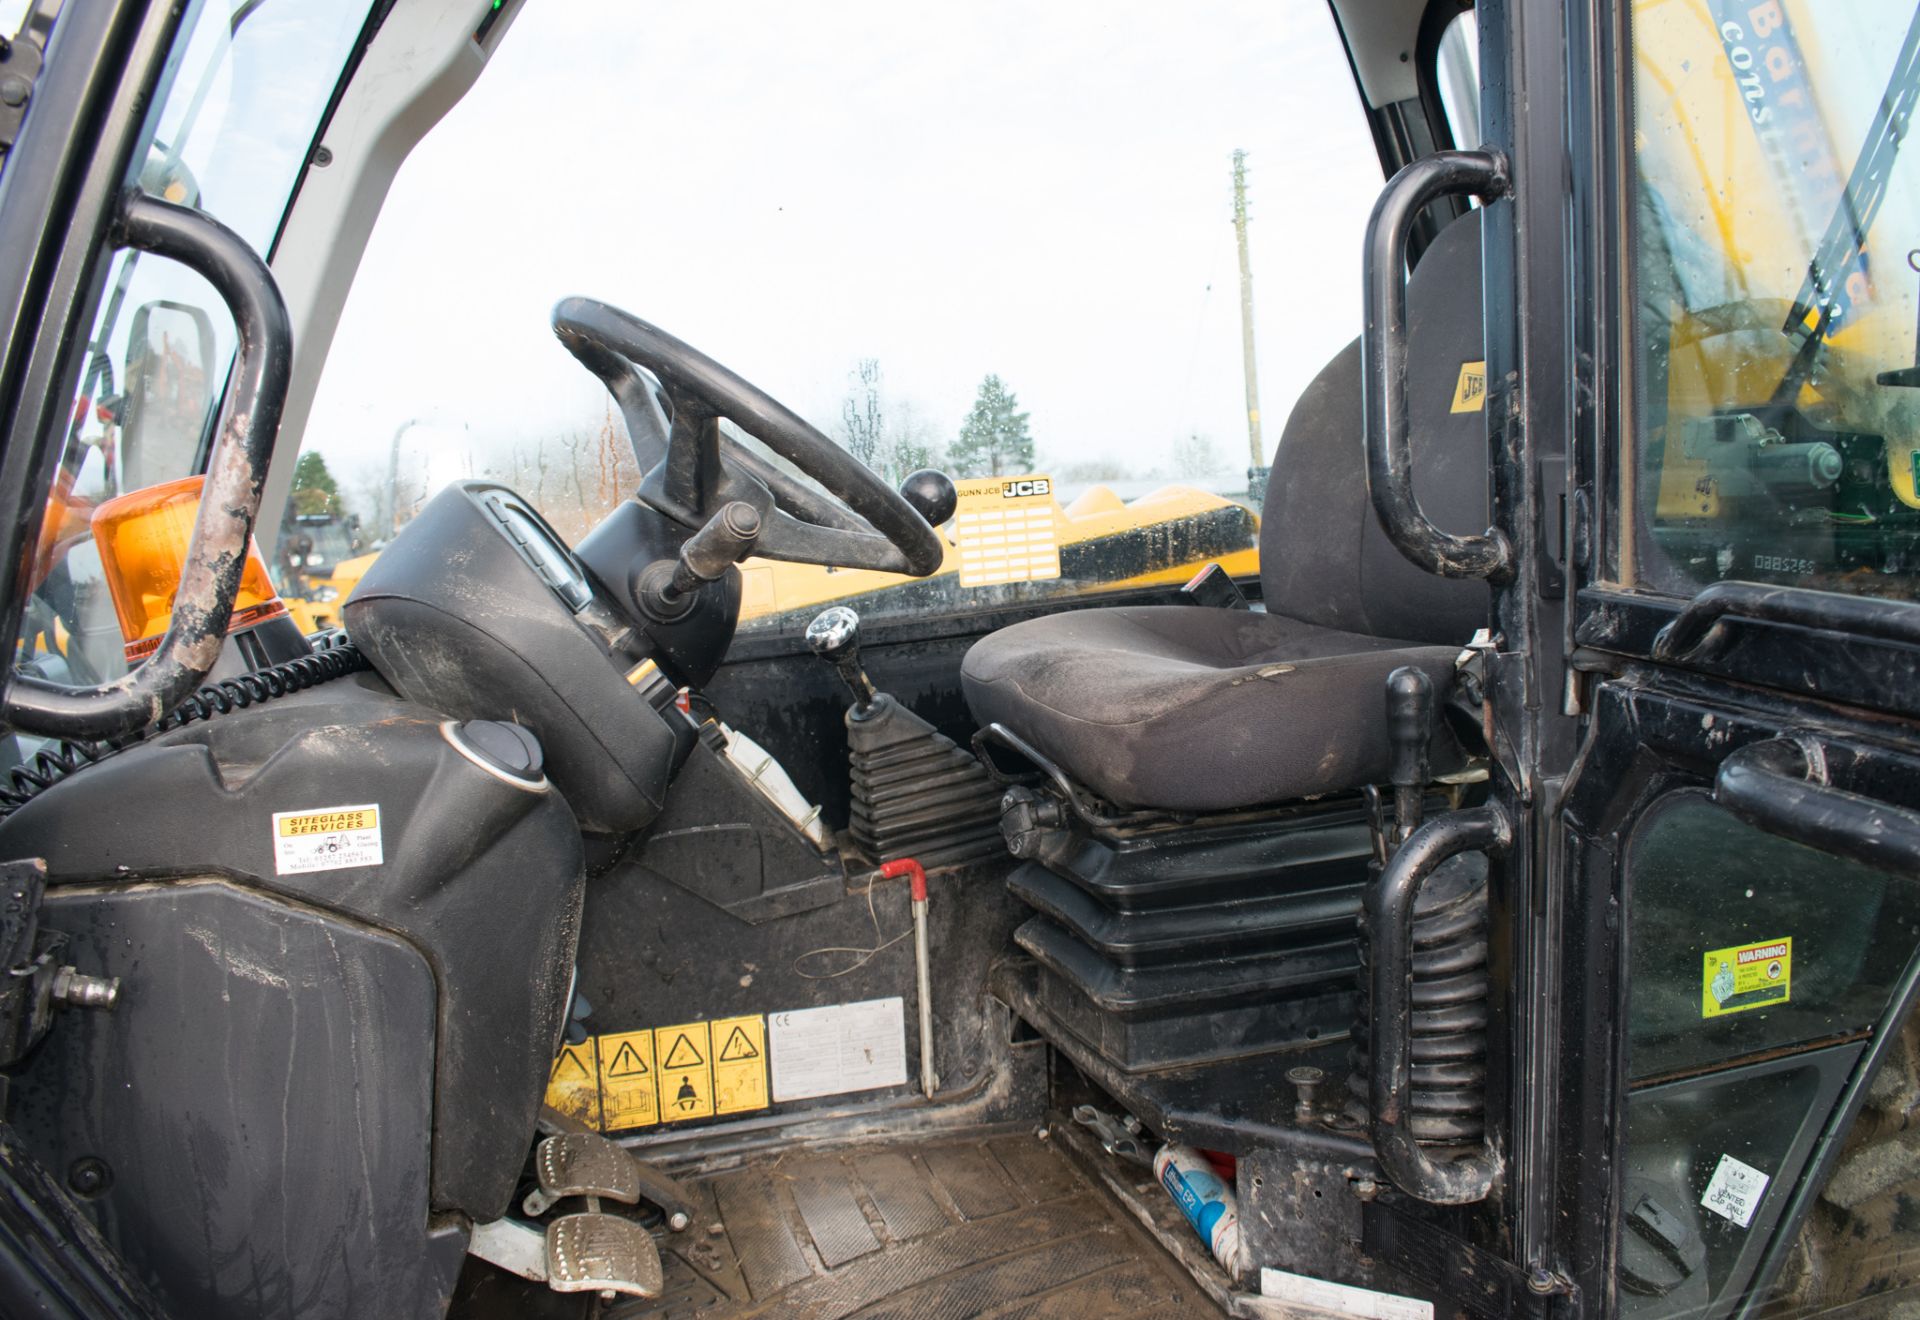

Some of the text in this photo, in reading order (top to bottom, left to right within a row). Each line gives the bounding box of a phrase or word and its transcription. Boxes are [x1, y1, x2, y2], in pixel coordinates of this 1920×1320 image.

[958, 487, 1000, 497] GUNN JCB
[1003, 480, 1049, 498] JCB
[290, 812, 363, 826] SITEGLASS
[290, 820, 364, 834] SERVICES
[1738, 945, 1786, 963] WARNING
[1710, 1194, 1745, 1217] CAP ONLY
[1717, 1188, 1745, 1207] VENTED
